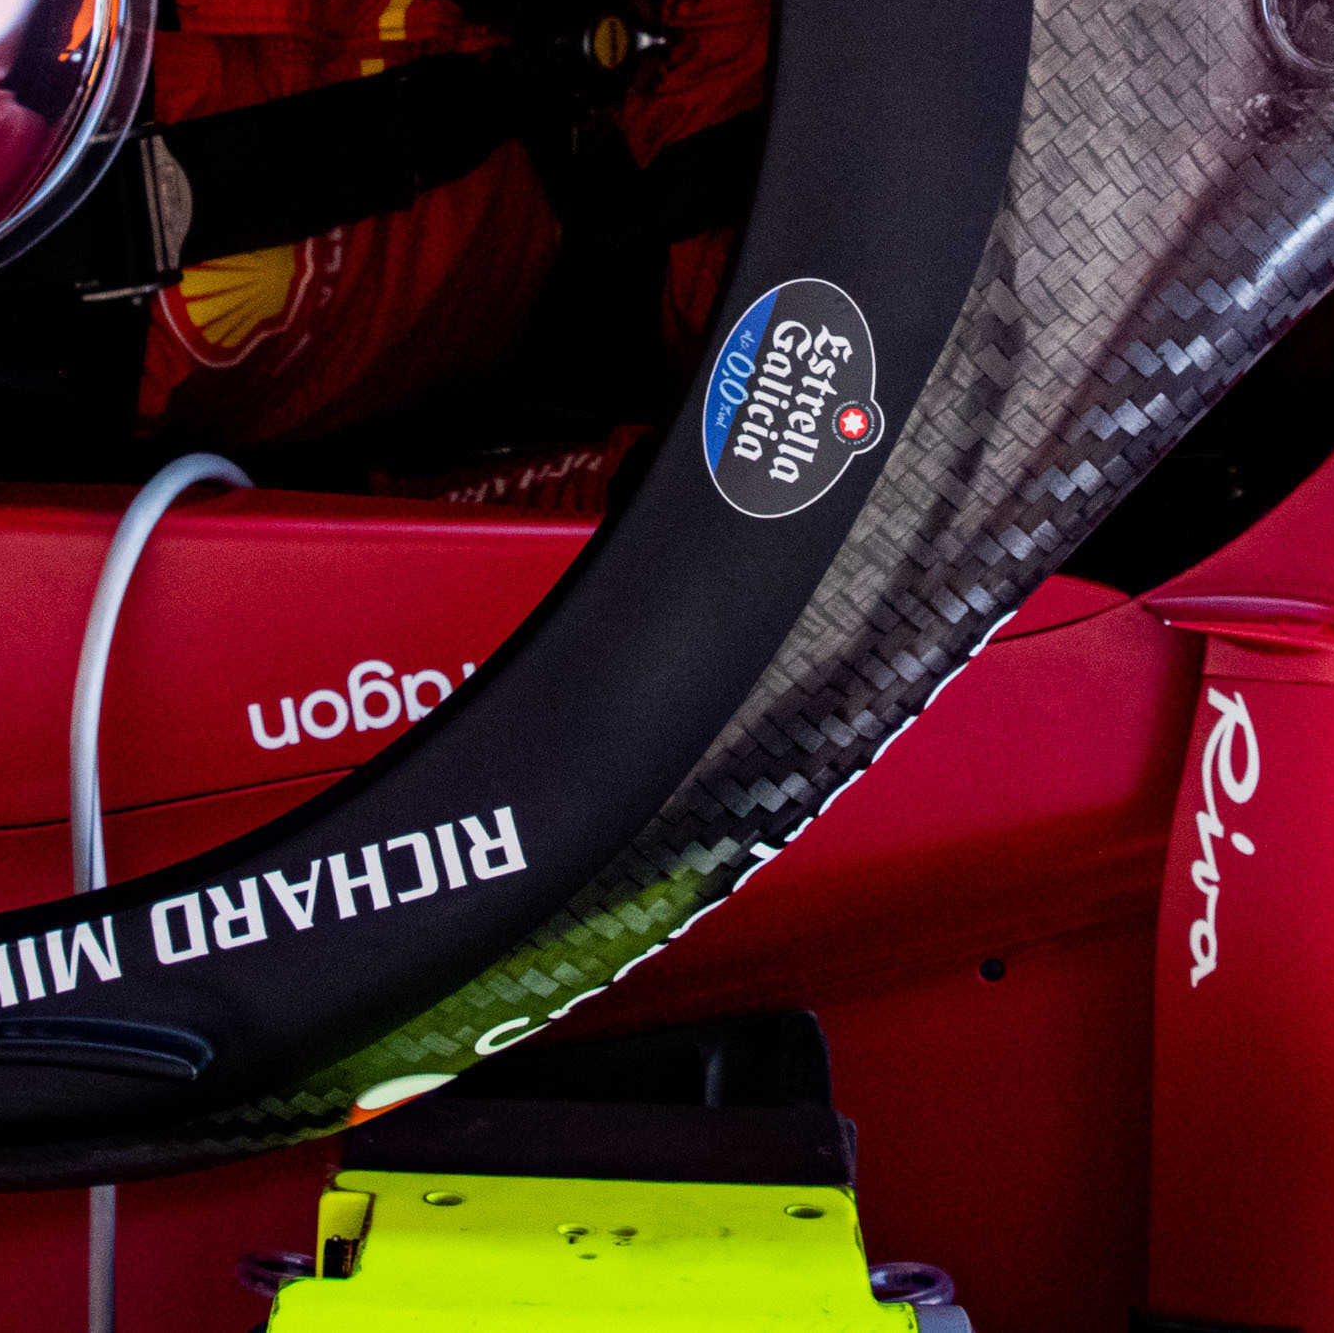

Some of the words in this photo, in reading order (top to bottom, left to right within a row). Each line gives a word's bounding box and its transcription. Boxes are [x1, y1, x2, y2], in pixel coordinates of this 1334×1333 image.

[719, 351, 757, 406] 0,0
[733, 319, 814, 463] Galicia
[769, 323, 854, 485] Estrella
[247, 659, 478, 750] agon
[150, 805, 528, 966] RICHARD
[1190, 688, 1262, 988] Riva
